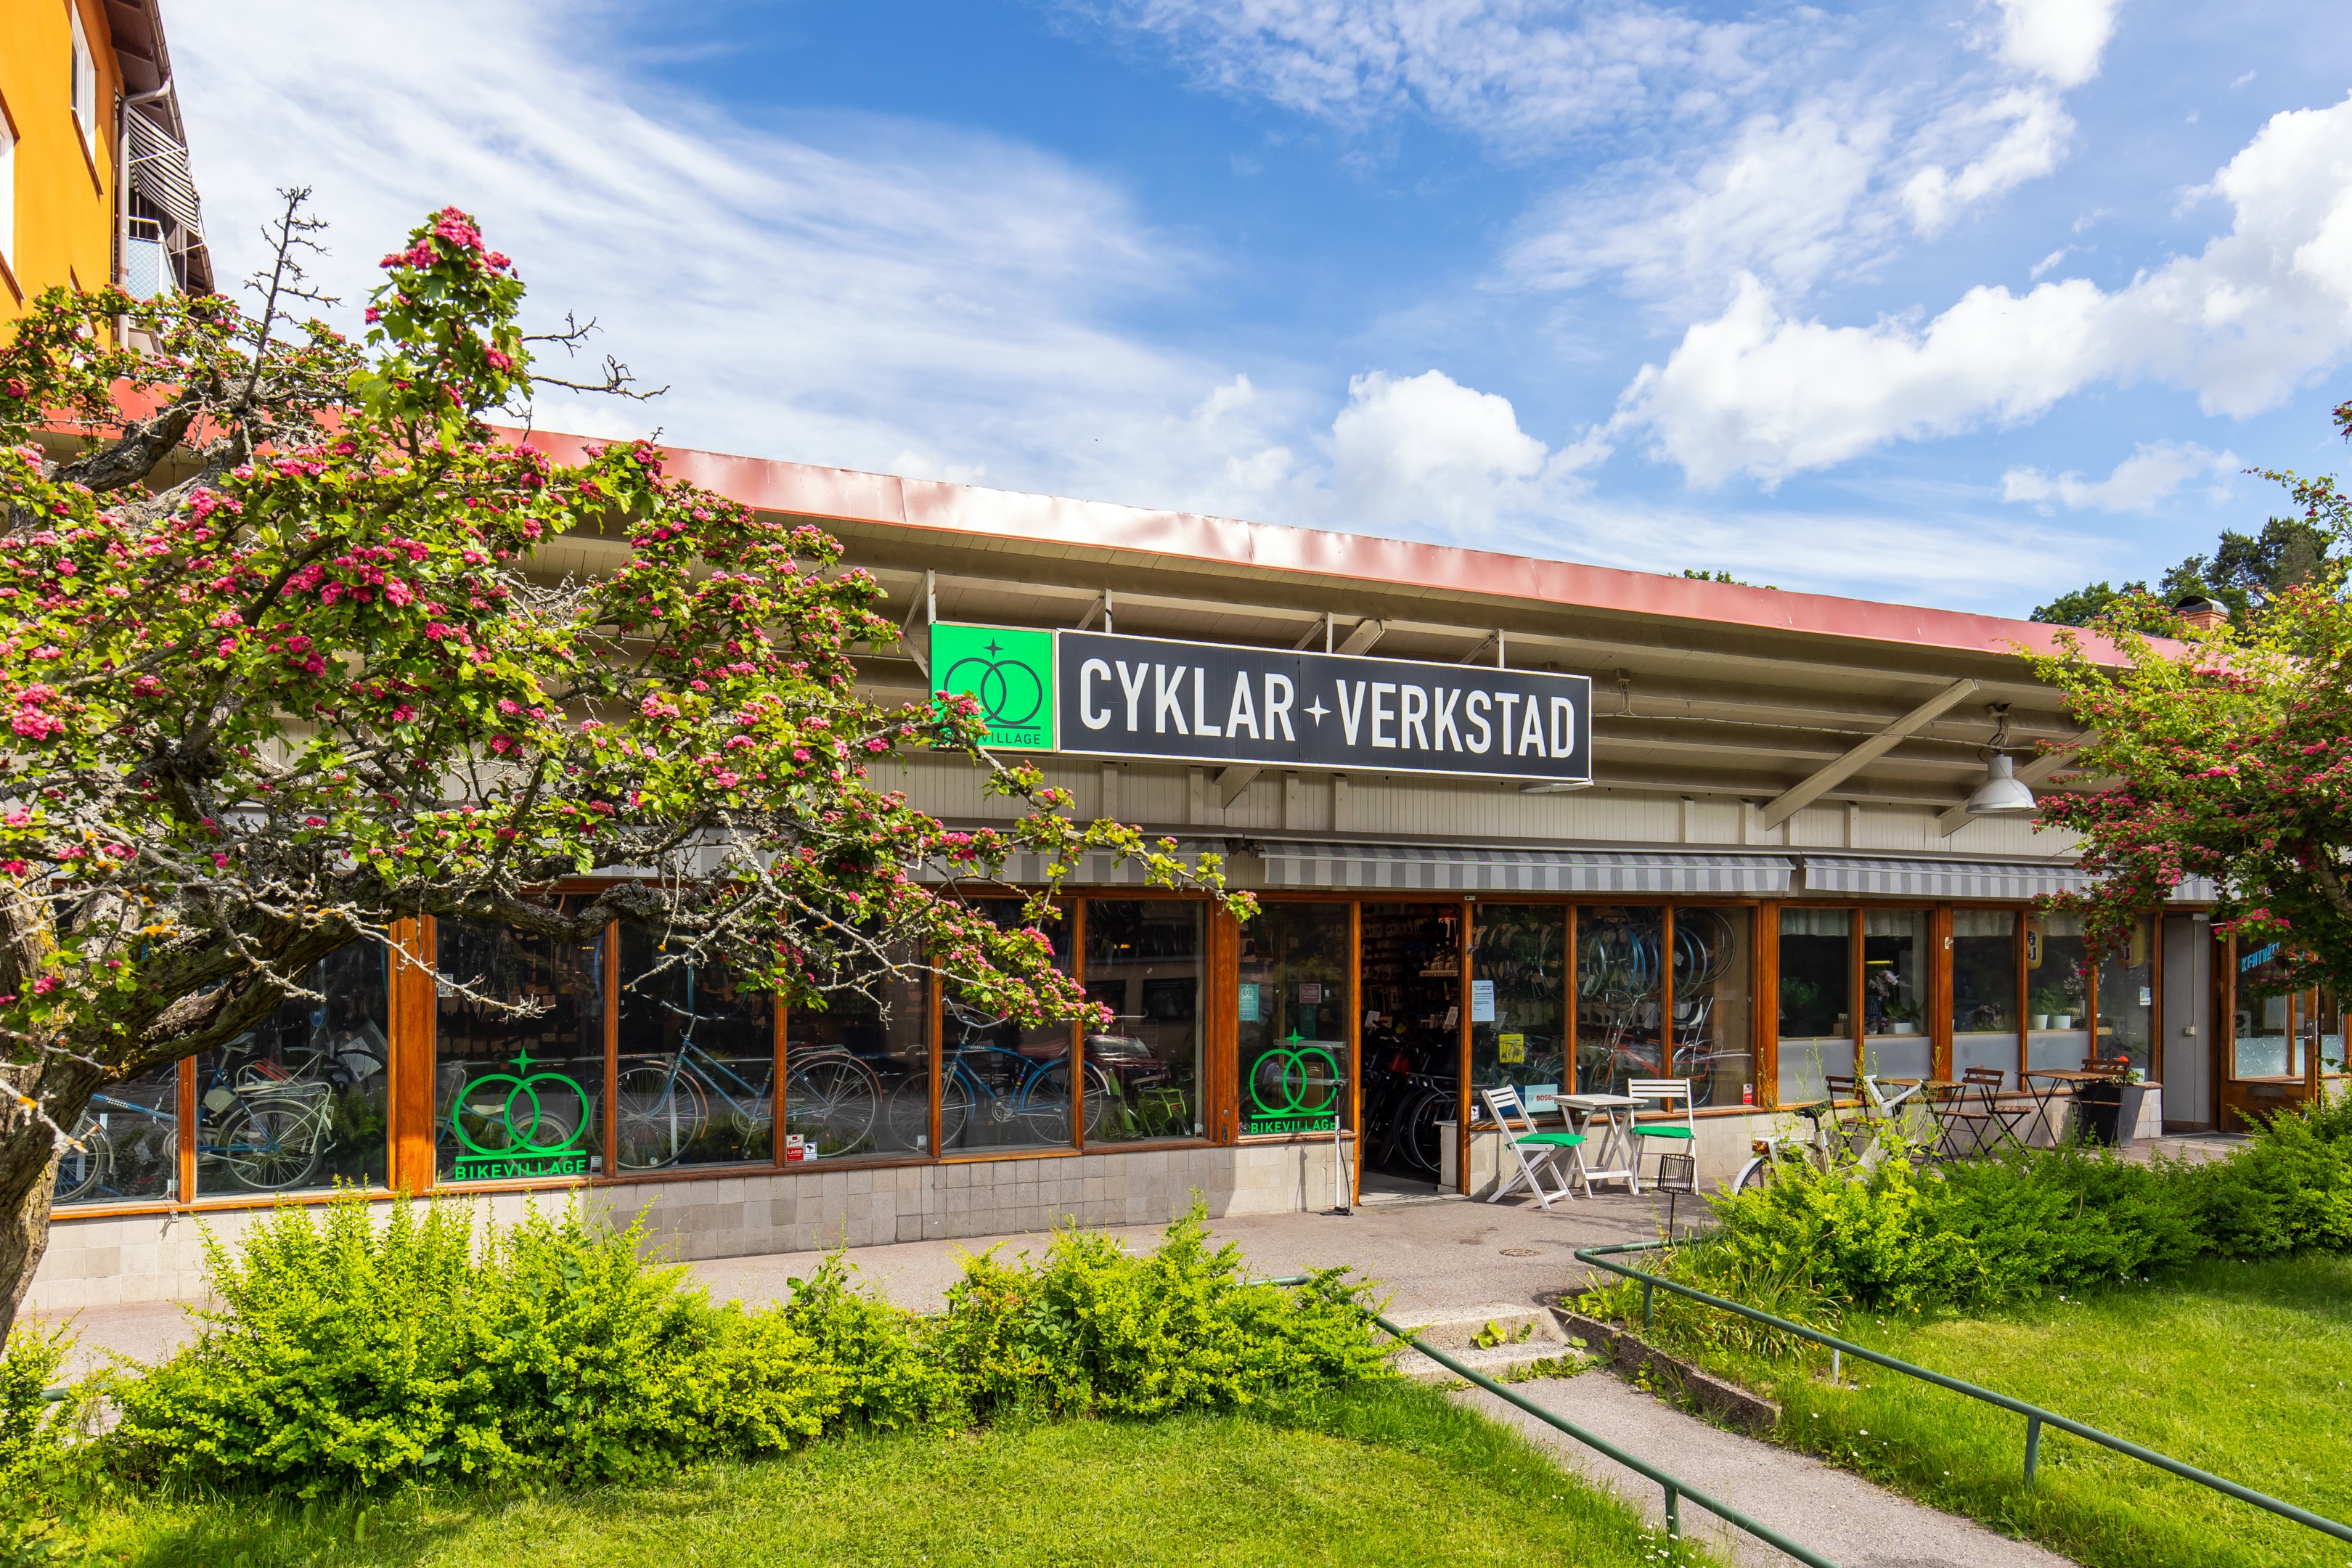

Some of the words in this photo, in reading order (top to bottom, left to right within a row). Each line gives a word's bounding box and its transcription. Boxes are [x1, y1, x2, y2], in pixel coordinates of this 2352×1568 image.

[1080, 658, 1296, 741] CYKLAR
[1336, 679, 1575, 758] VERKSTAD
[981, 732, 1041, 745] VILLAGE
[455, 1159, 586, 1180] BIKEVILLAGE
